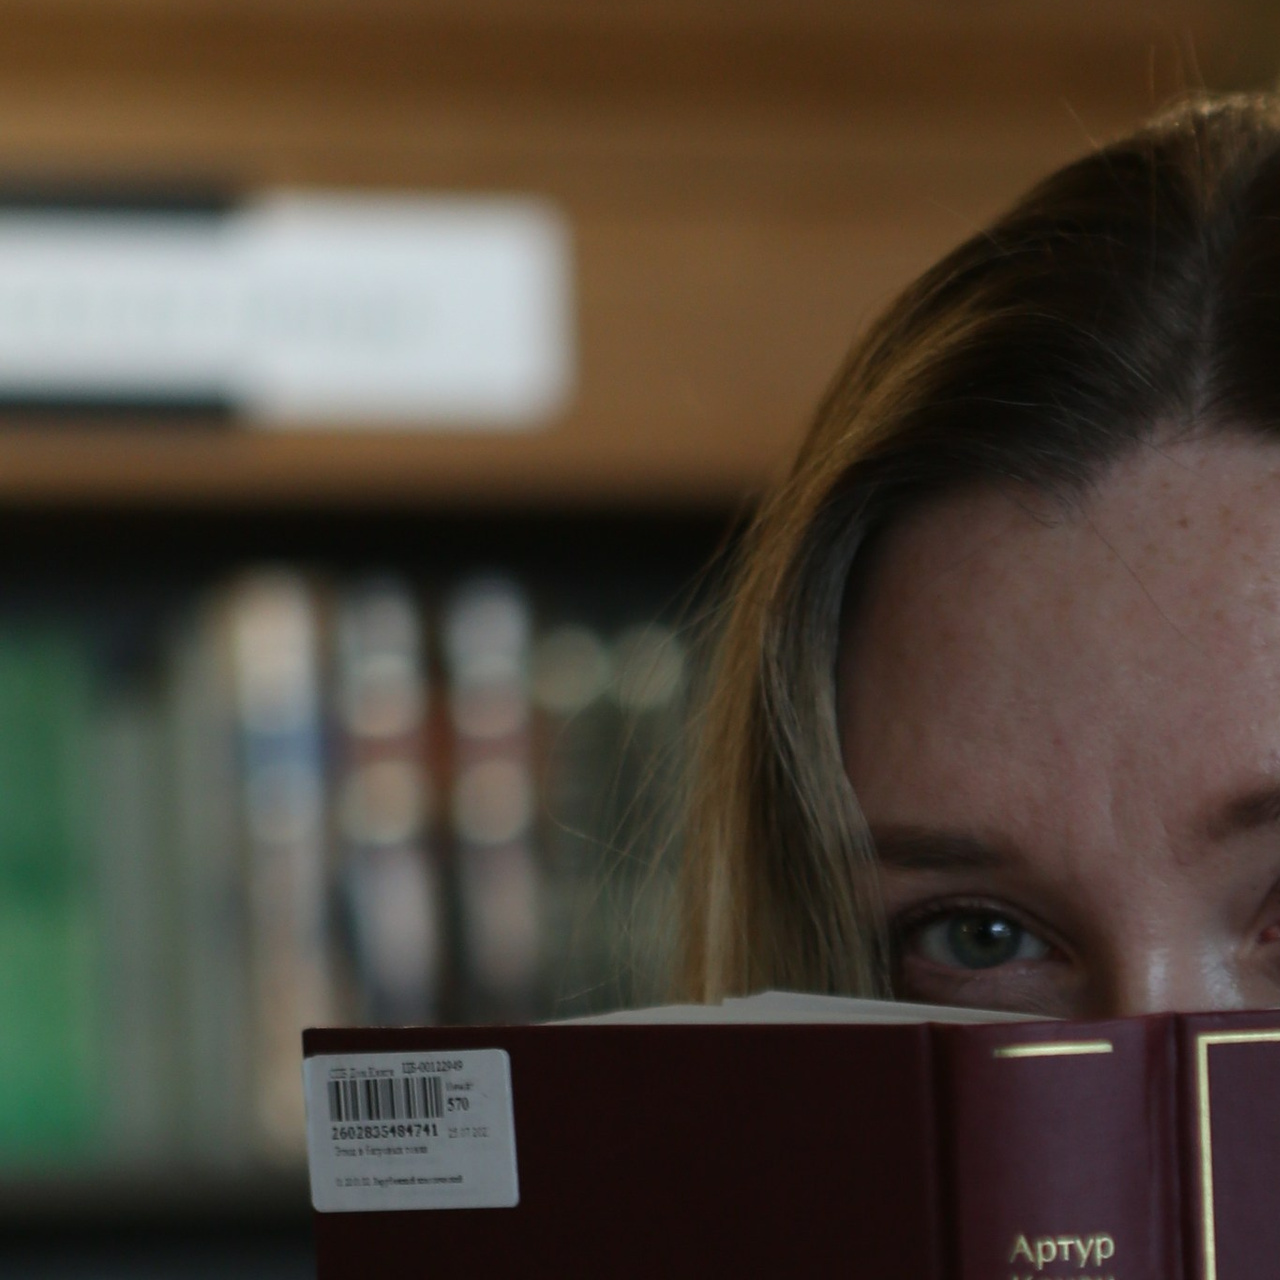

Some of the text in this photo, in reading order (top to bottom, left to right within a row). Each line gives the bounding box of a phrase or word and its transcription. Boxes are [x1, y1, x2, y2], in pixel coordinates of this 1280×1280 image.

[447, 1097, 470, 1112] 570
[332, 1124, 439, 1140] 2602835484741
[1010, 1235, 1116, 1270] Артур
